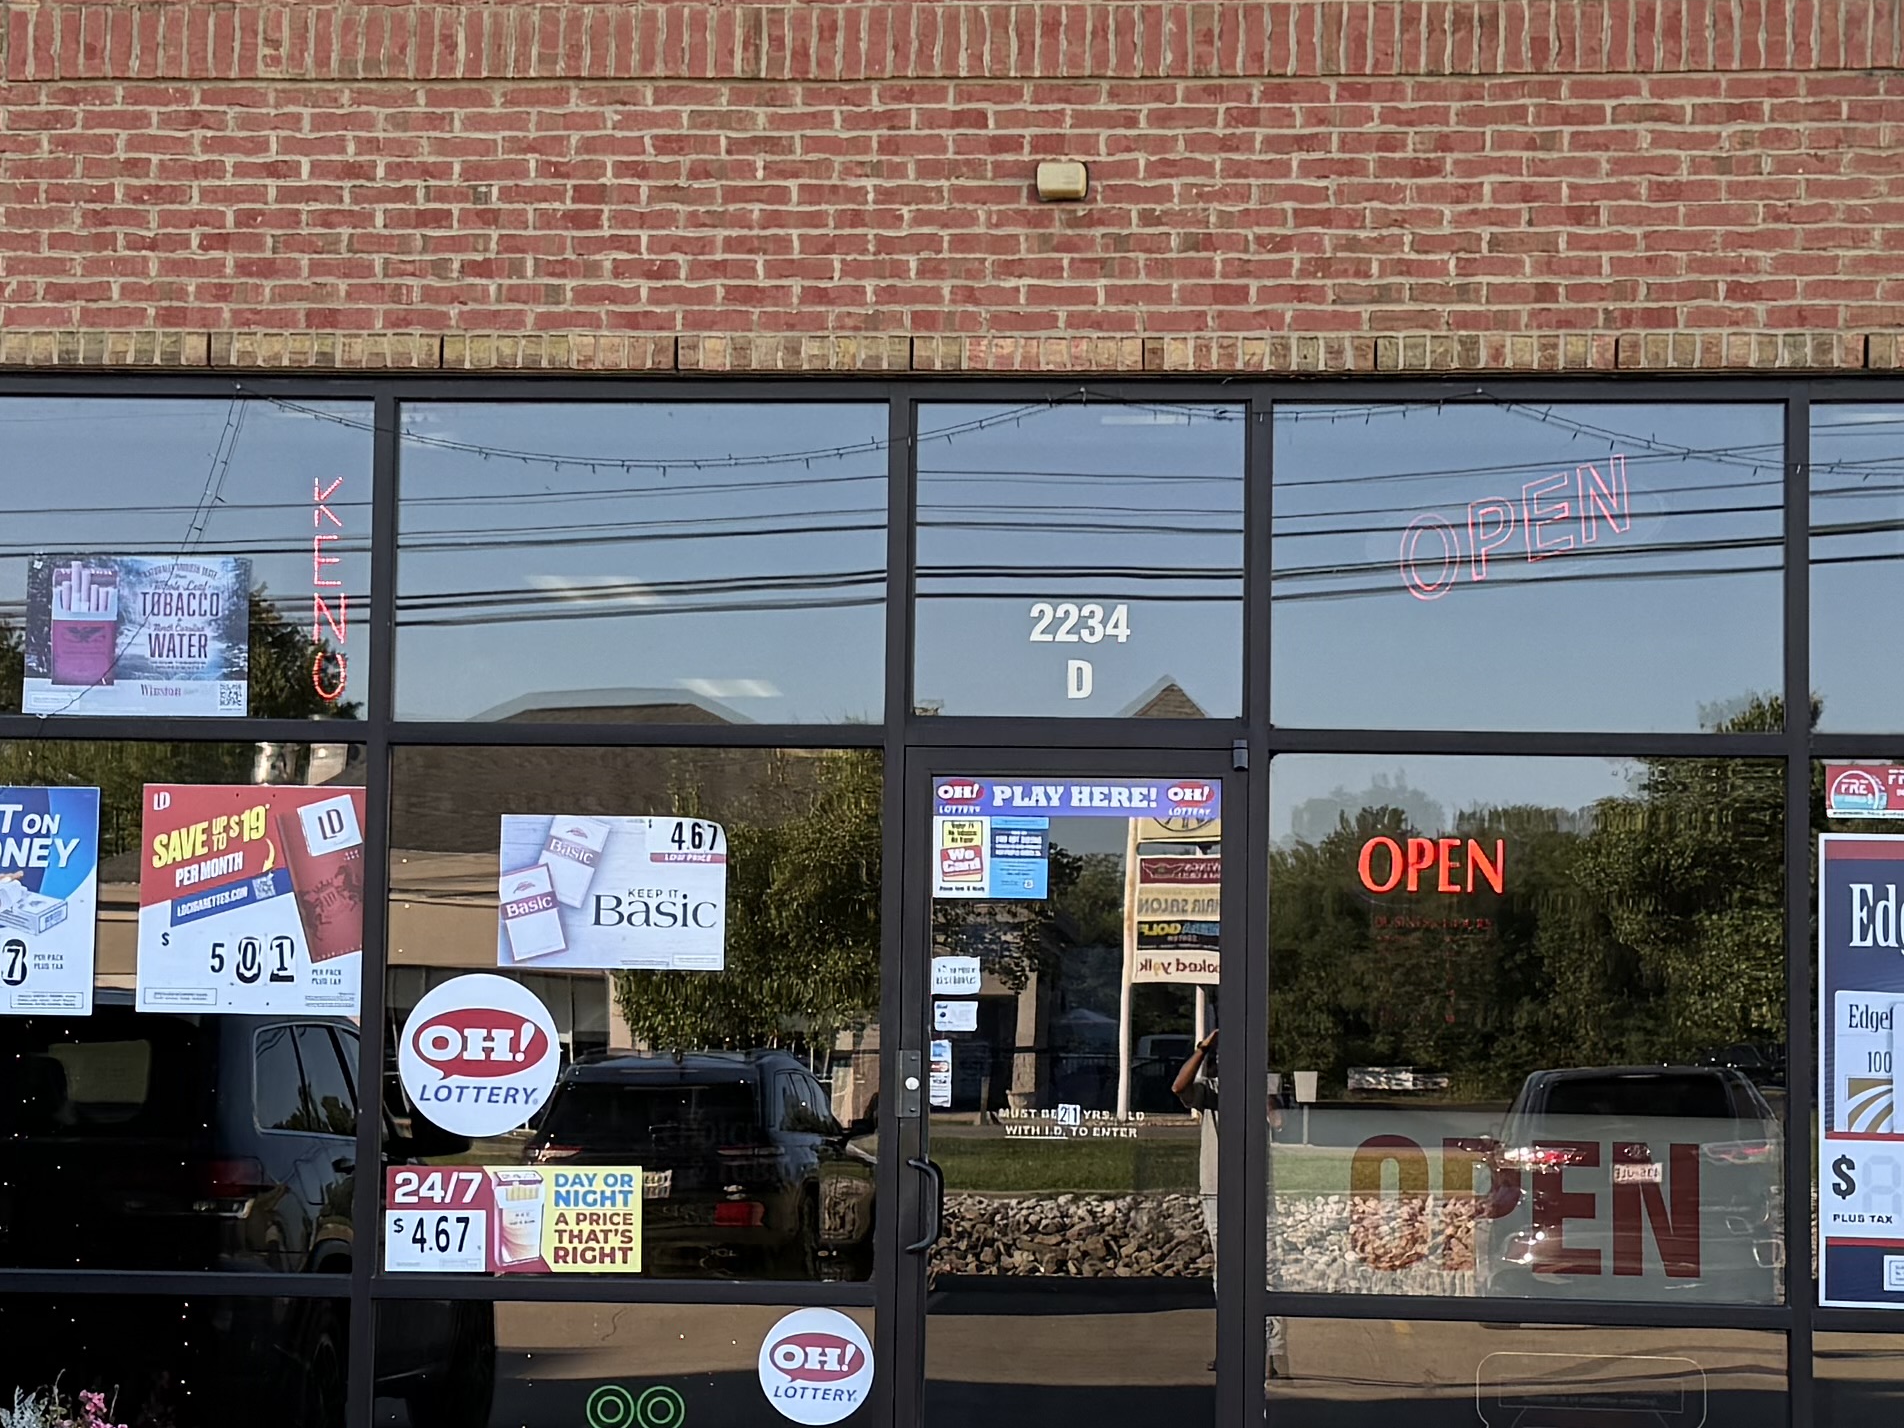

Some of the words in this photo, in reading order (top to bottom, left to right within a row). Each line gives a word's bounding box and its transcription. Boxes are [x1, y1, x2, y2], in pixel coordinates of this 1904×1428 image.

[1400, 454, 1632, 602] OPEN
[312, 476, 347, 701] KENO
[140, 592, 220, 617] TOBACCO
[1030, 603, 1131, 645] 2234
[148, 632, 208, 659] WATER
[1066, 660, 1093, 699] D
[153, 791, 172, 811] LD
[938, 783, 979, 799] OH!
[992, 785, 1064, 807] PLAY
[1070, 786, 1158, 809] HERE!
[1167, 785, 1209, 801] OH!
[22, 813, 61, 835] ON
[317, 808, 345, 842] LD
[152, 820, 210, 869] SAVE
[211, 815, 228, 835] UP
[211, 834, 227, 853] TO
[549, 837, 595, 865] Basic
[175, 865, 199, 889] PER
[199, 851, 245, 882] MONTH
[1358, 835, 1505, 894] OPEN
[628, 888, 664, 899] KEEP
[668, 889, 679, 899] IT
[505, 894, 554, 918] Basic
[592, 893, 718, 929] Basic
[418, 1021, 536, 1063] OH!
[418, 1083, 536, 1106] LOTTERY
[998, 1108, 1038, 1119] MUST
[1059, 1106, 1079, 1125] 21
[1005, 1125, 1041, 1136] WITH
[1070, 1127, 1088, 1137] TO
[1092, 1127, 1138, 1139] ENTER
[394, 1171, 484, 1204] 24/7
[554, 1173, 599, 1188] DAY
[603, 1173, 634, 1188] OR
[1831, 1154, 1856, 1200] $
[554, 1189, 634, 1208] NIGHT
[1350, 1134, 1701, 1279] OPEN
[555, 1212, 572, 1227] A
[575, 1212, 634, 1227] PRICE
[1832, 1213, 1866, 1224] PLUS
[1868, 1214, 1894, 1224] TAX
[393, 1217, 404, 1234] $
[411, 1215, 470, 1254] 4.67
[554, 1228, 634, 1245] THAT'S
[553, 1246, 634, 1265] RIGHT
[773, 1343, 858, 1372] OH!
[773, 1384, 857, 1403] LOTTERY
